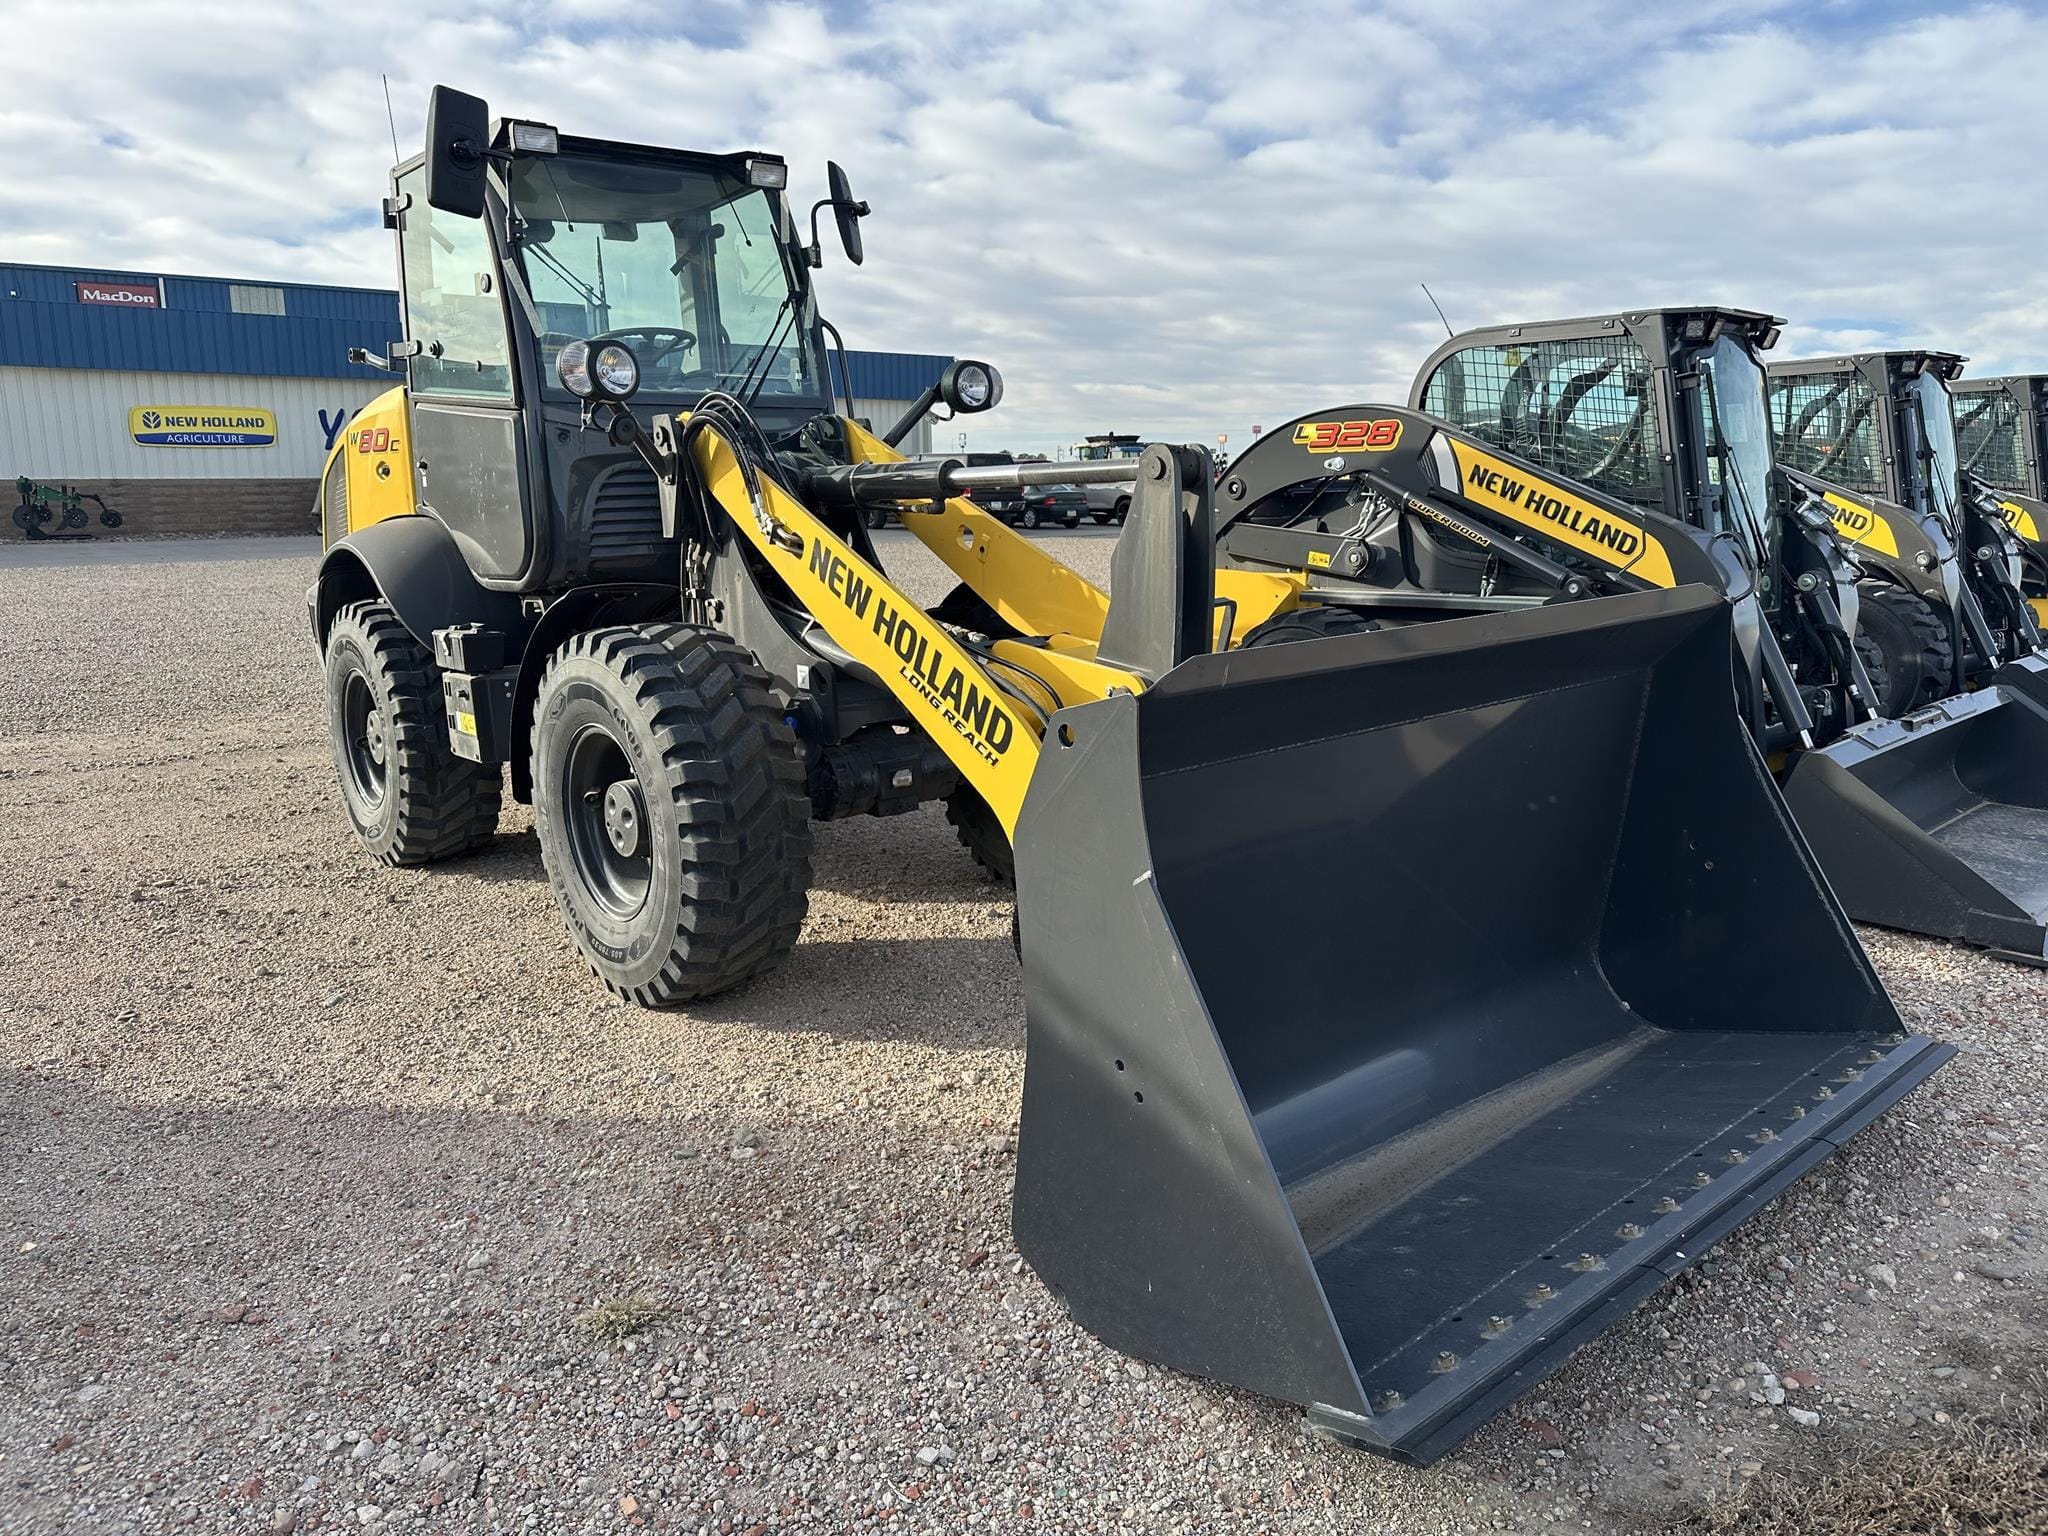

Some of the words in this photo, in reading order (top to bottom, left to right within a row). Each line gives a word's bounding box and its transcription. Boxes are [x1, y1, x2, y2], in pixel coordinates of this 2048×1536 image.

[83, 289, 155, 304] MacDon
[165, 416, 198, 428] NEW
[201, 416, 265, 429] HOLLAND
[166, 434, 245, 444] AGRICULTURE
[1295, 420, 1400, 448] L328
[1408, 499, 1450, 528] SUPER
[1450, 518, 1491, 547] BOOM
[1468, 463, 1525, 503] NEW
[1526, 490, 1638, 556] HOLLAND
[808, 537, 873, 620] NEW
[873, 598, 1013, 755] HOLLAND
[899, 666, 943, 709] LONG
[942, 709, 1000, 767] REACH
